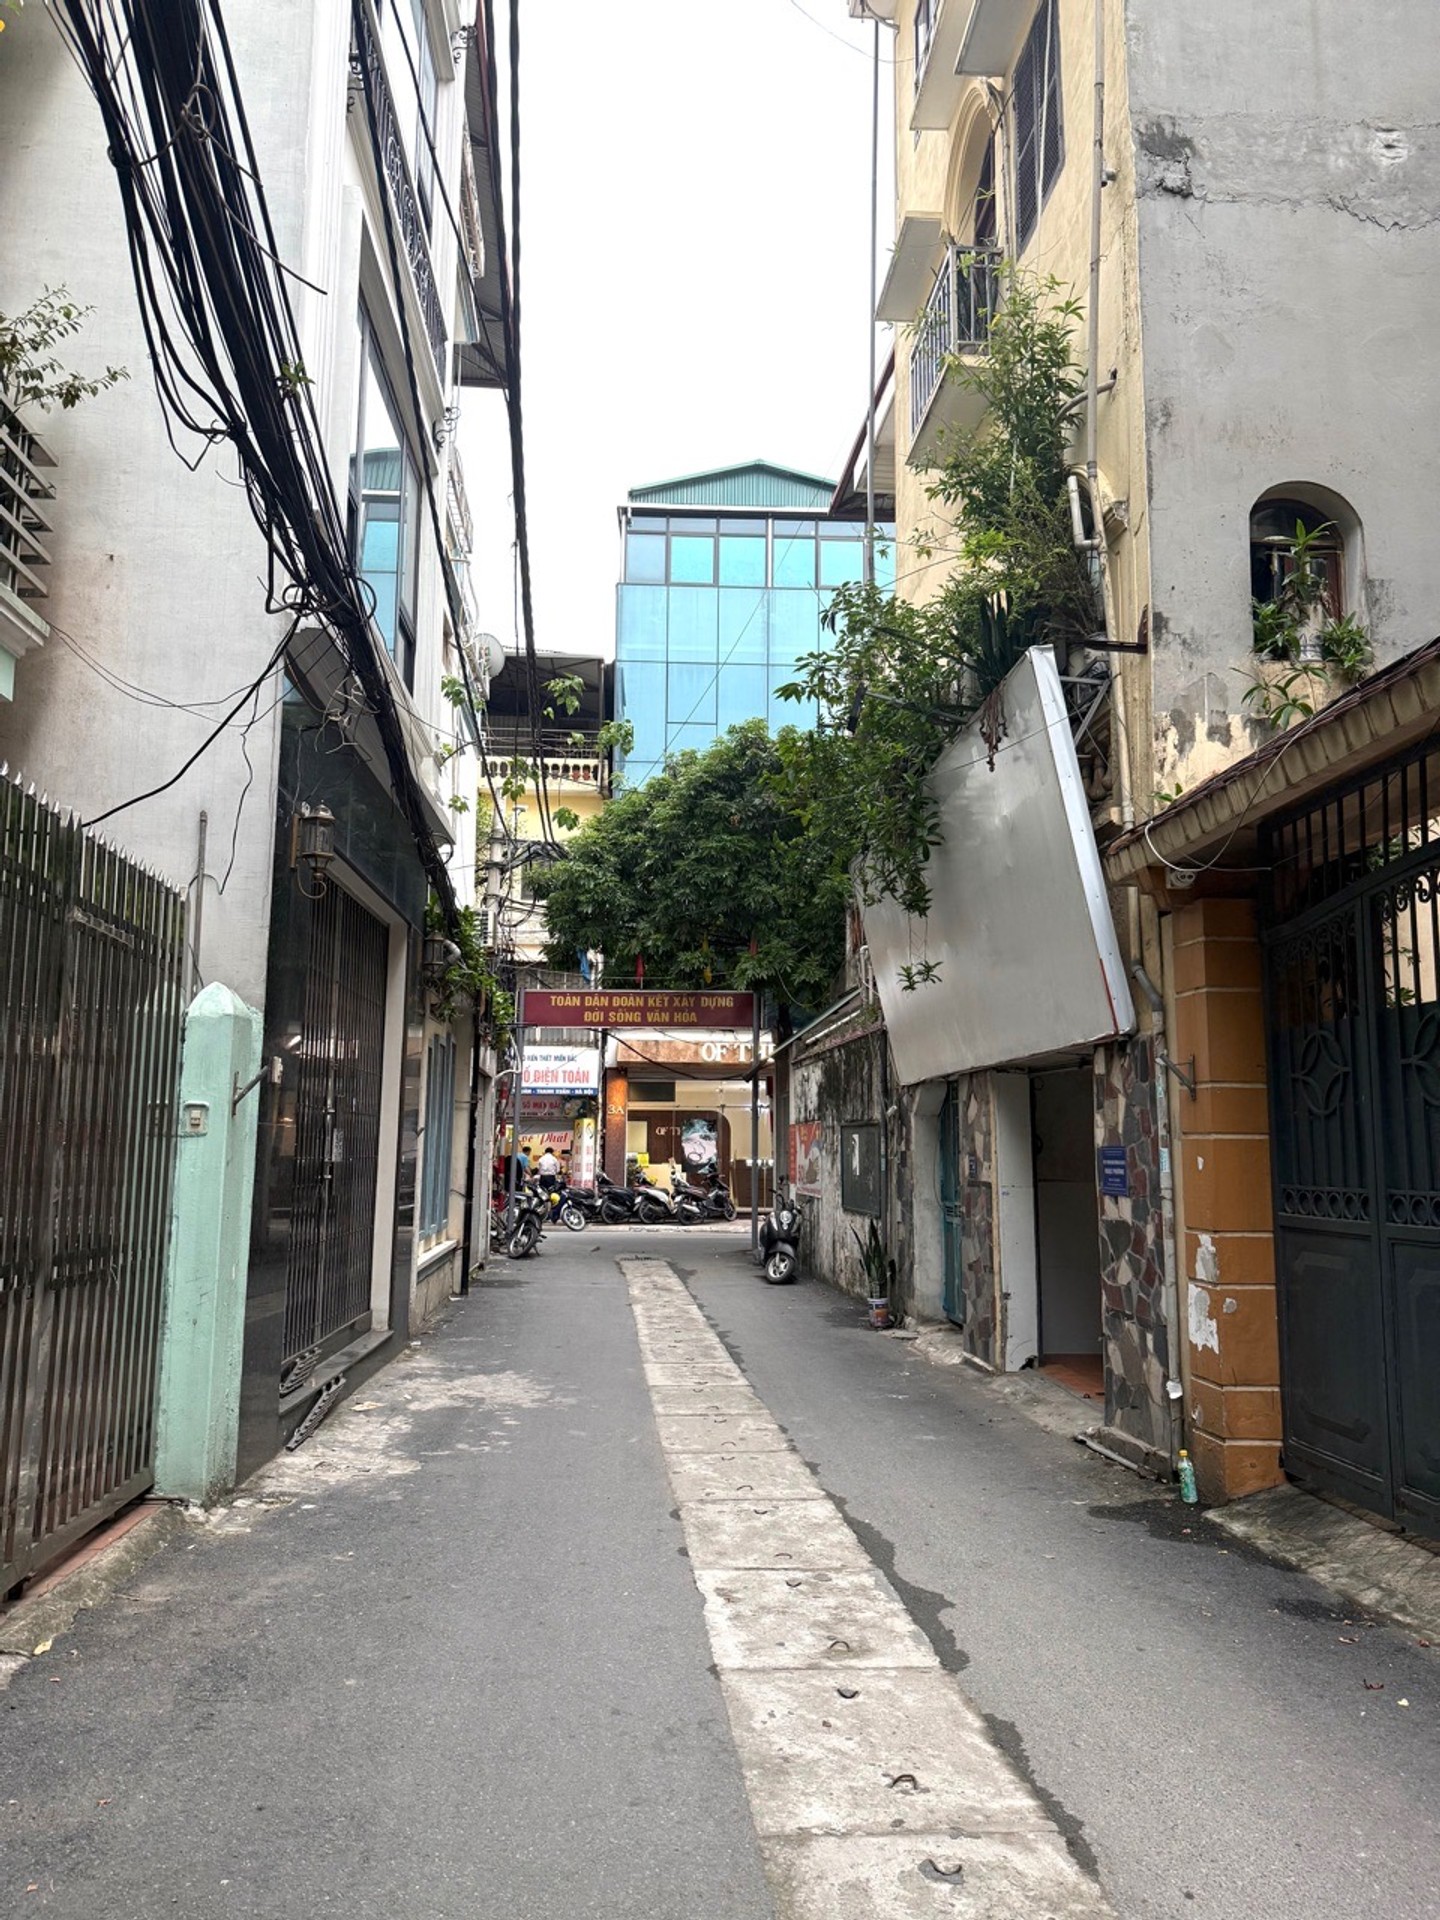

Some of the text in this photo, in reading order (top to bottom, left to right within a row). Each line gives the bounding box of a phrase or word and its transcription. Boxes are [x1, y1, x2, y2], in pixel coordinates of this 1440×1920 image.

[550, 993, 734, 1010] TOÀN DÂN ĐOÀN KẾT XÂY DỰNG
[583, 1007, 697, 1022] ĐỜI SỐNG VĂN HÓA
[701, 1042, 728, 1062] OF
[534, 1066, 559, 1085] ĐIỆN
[562, 1067, 589, 1083] TOÁN
[607, 1105, 625, 1115] 3A
